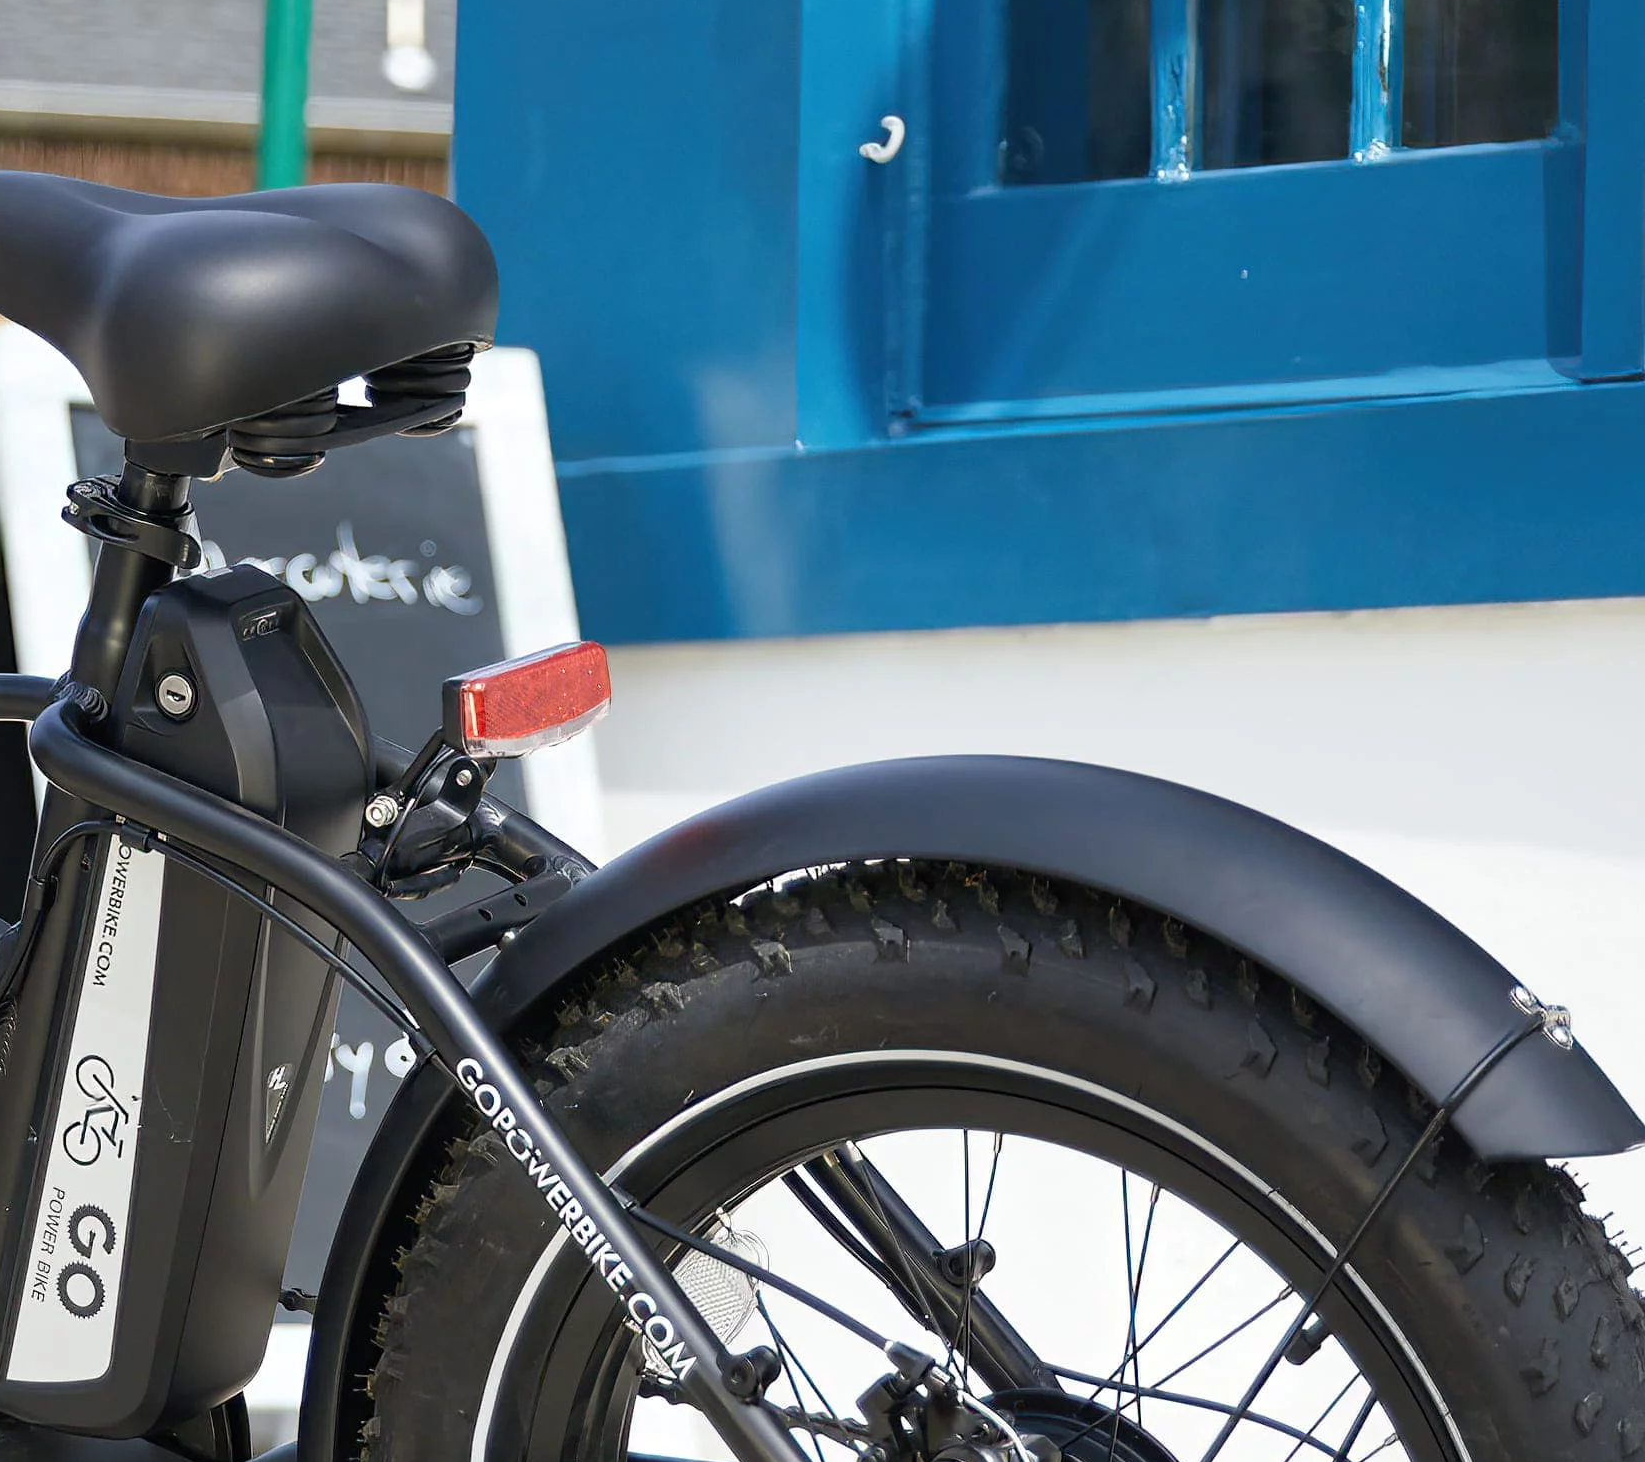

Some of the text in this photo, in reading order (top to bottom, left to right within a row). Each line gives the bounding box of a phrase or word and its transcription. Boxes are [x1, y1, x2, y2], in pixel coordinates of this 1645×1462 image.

[92, 842, 132, 987] OWERBIKE.COM
[31, 1186, 66, 1303] POWER BIKE
[55, 1202, 117, 1320] GO
[455, 1057, 698, 1381] GOPOWERBIKE.COM
